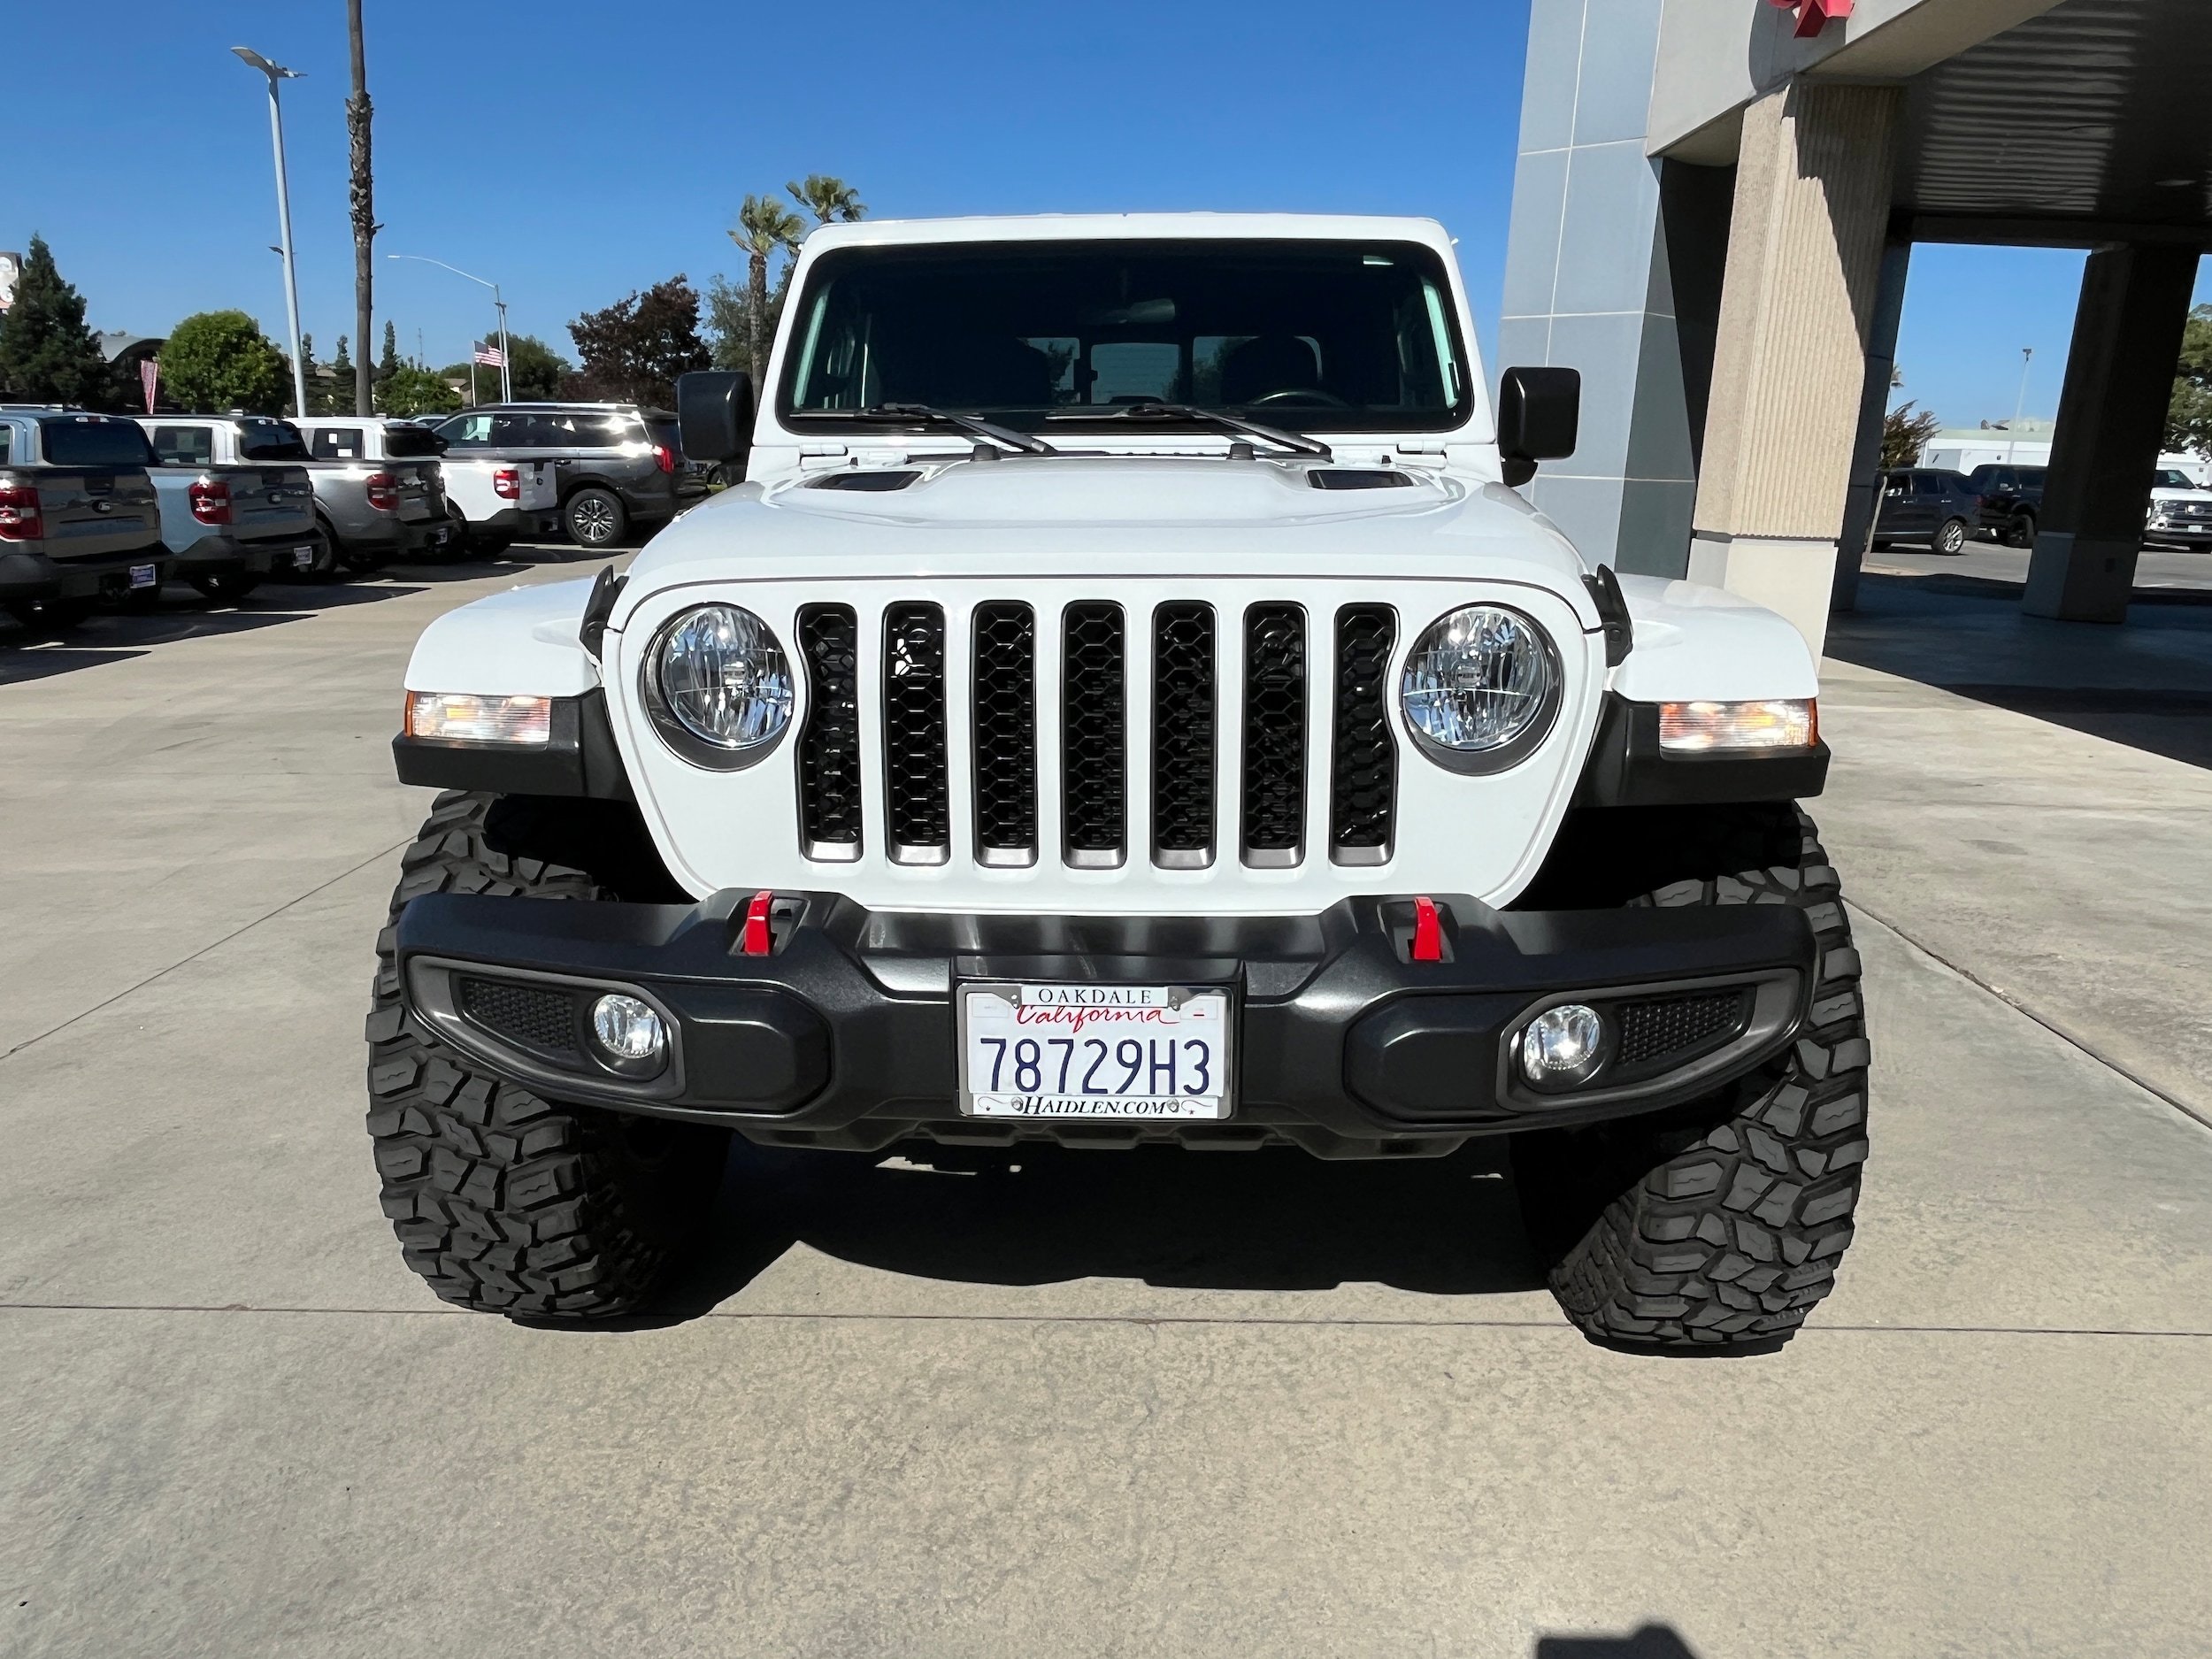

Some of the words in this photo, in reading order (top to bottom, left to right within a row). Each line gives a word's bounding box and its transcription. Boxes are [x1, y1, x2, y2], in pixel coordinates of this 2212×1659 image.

[1039, 988, 1152, 1004] OAKDALE
[1016, 1005, 1180, 1033] California
[980, 1038, 1210, 1094] 78729H3
